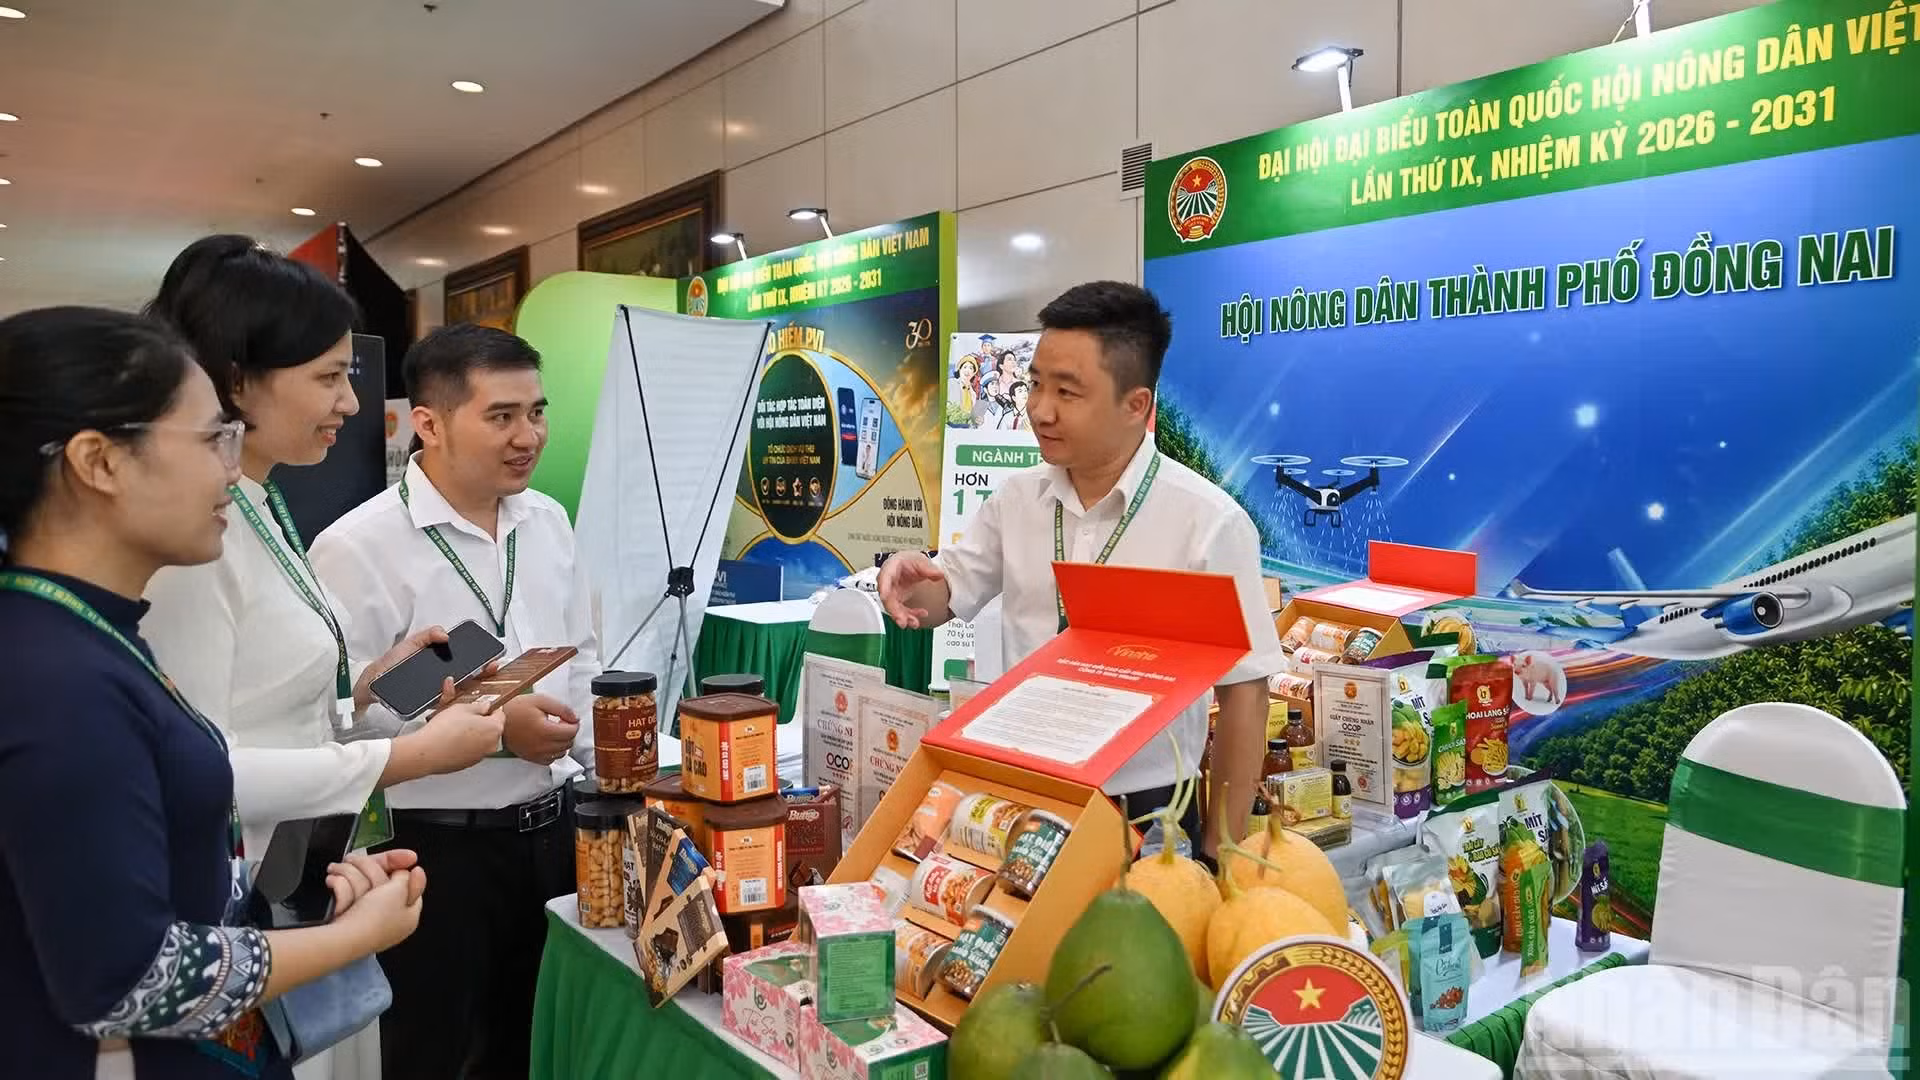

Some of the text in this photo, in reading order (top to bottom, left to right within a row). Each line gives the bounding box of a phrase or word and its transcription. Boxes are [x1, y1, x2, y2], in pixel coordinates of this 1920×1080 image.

[1258, 147, 1291, 183] ĐẠI
[1295, 135, 1329, 175] HỘI
[1335, 128, 1370, 167] ĐẠI
[1376, 107, 1429, 155] BIỂU
[1435, 97, 1501, 142] TOÀN
[1508, 74, 1584, 129] QUỐC
[1591, 63, 1642, 113] HỘI
[1652, 44, 1745, 97] NÔNG
[1756, 23, 1834, 75] DÂN
[1351, 165, 1393, 206] LẦN
[1400, 155, 1447, 197] THỨ
[1451, 154, 1483, 188] IX,
[1491, 133, 1581, 181] NHIỆM
[1590, 120, 1629, 164] KỲ
[1637, 110, 1716, 156] 2026
[1749, 85, 1836, 136] 2031
[881, 232, 903, 256] VIỆT
[905, 226, 929, 251] NAM
[859, 267, 882, 290] 2031
[1220, 224, 1895, 344] HỘI NÔNG DÂN THÀNH PHỐ ĐỒNG NAI
[972, 447, 1024, 464] NGÀNH
[954, 472, 989, 487] HƠN
[952, 488, 965, 516] 1
[1411, 694, 1426, 711] MÍT
[1484, 708, 1503, 718] LANG
[1341, 722, 1362, 733] OCOP
[1524, 812, 1544, 830] MÍT
